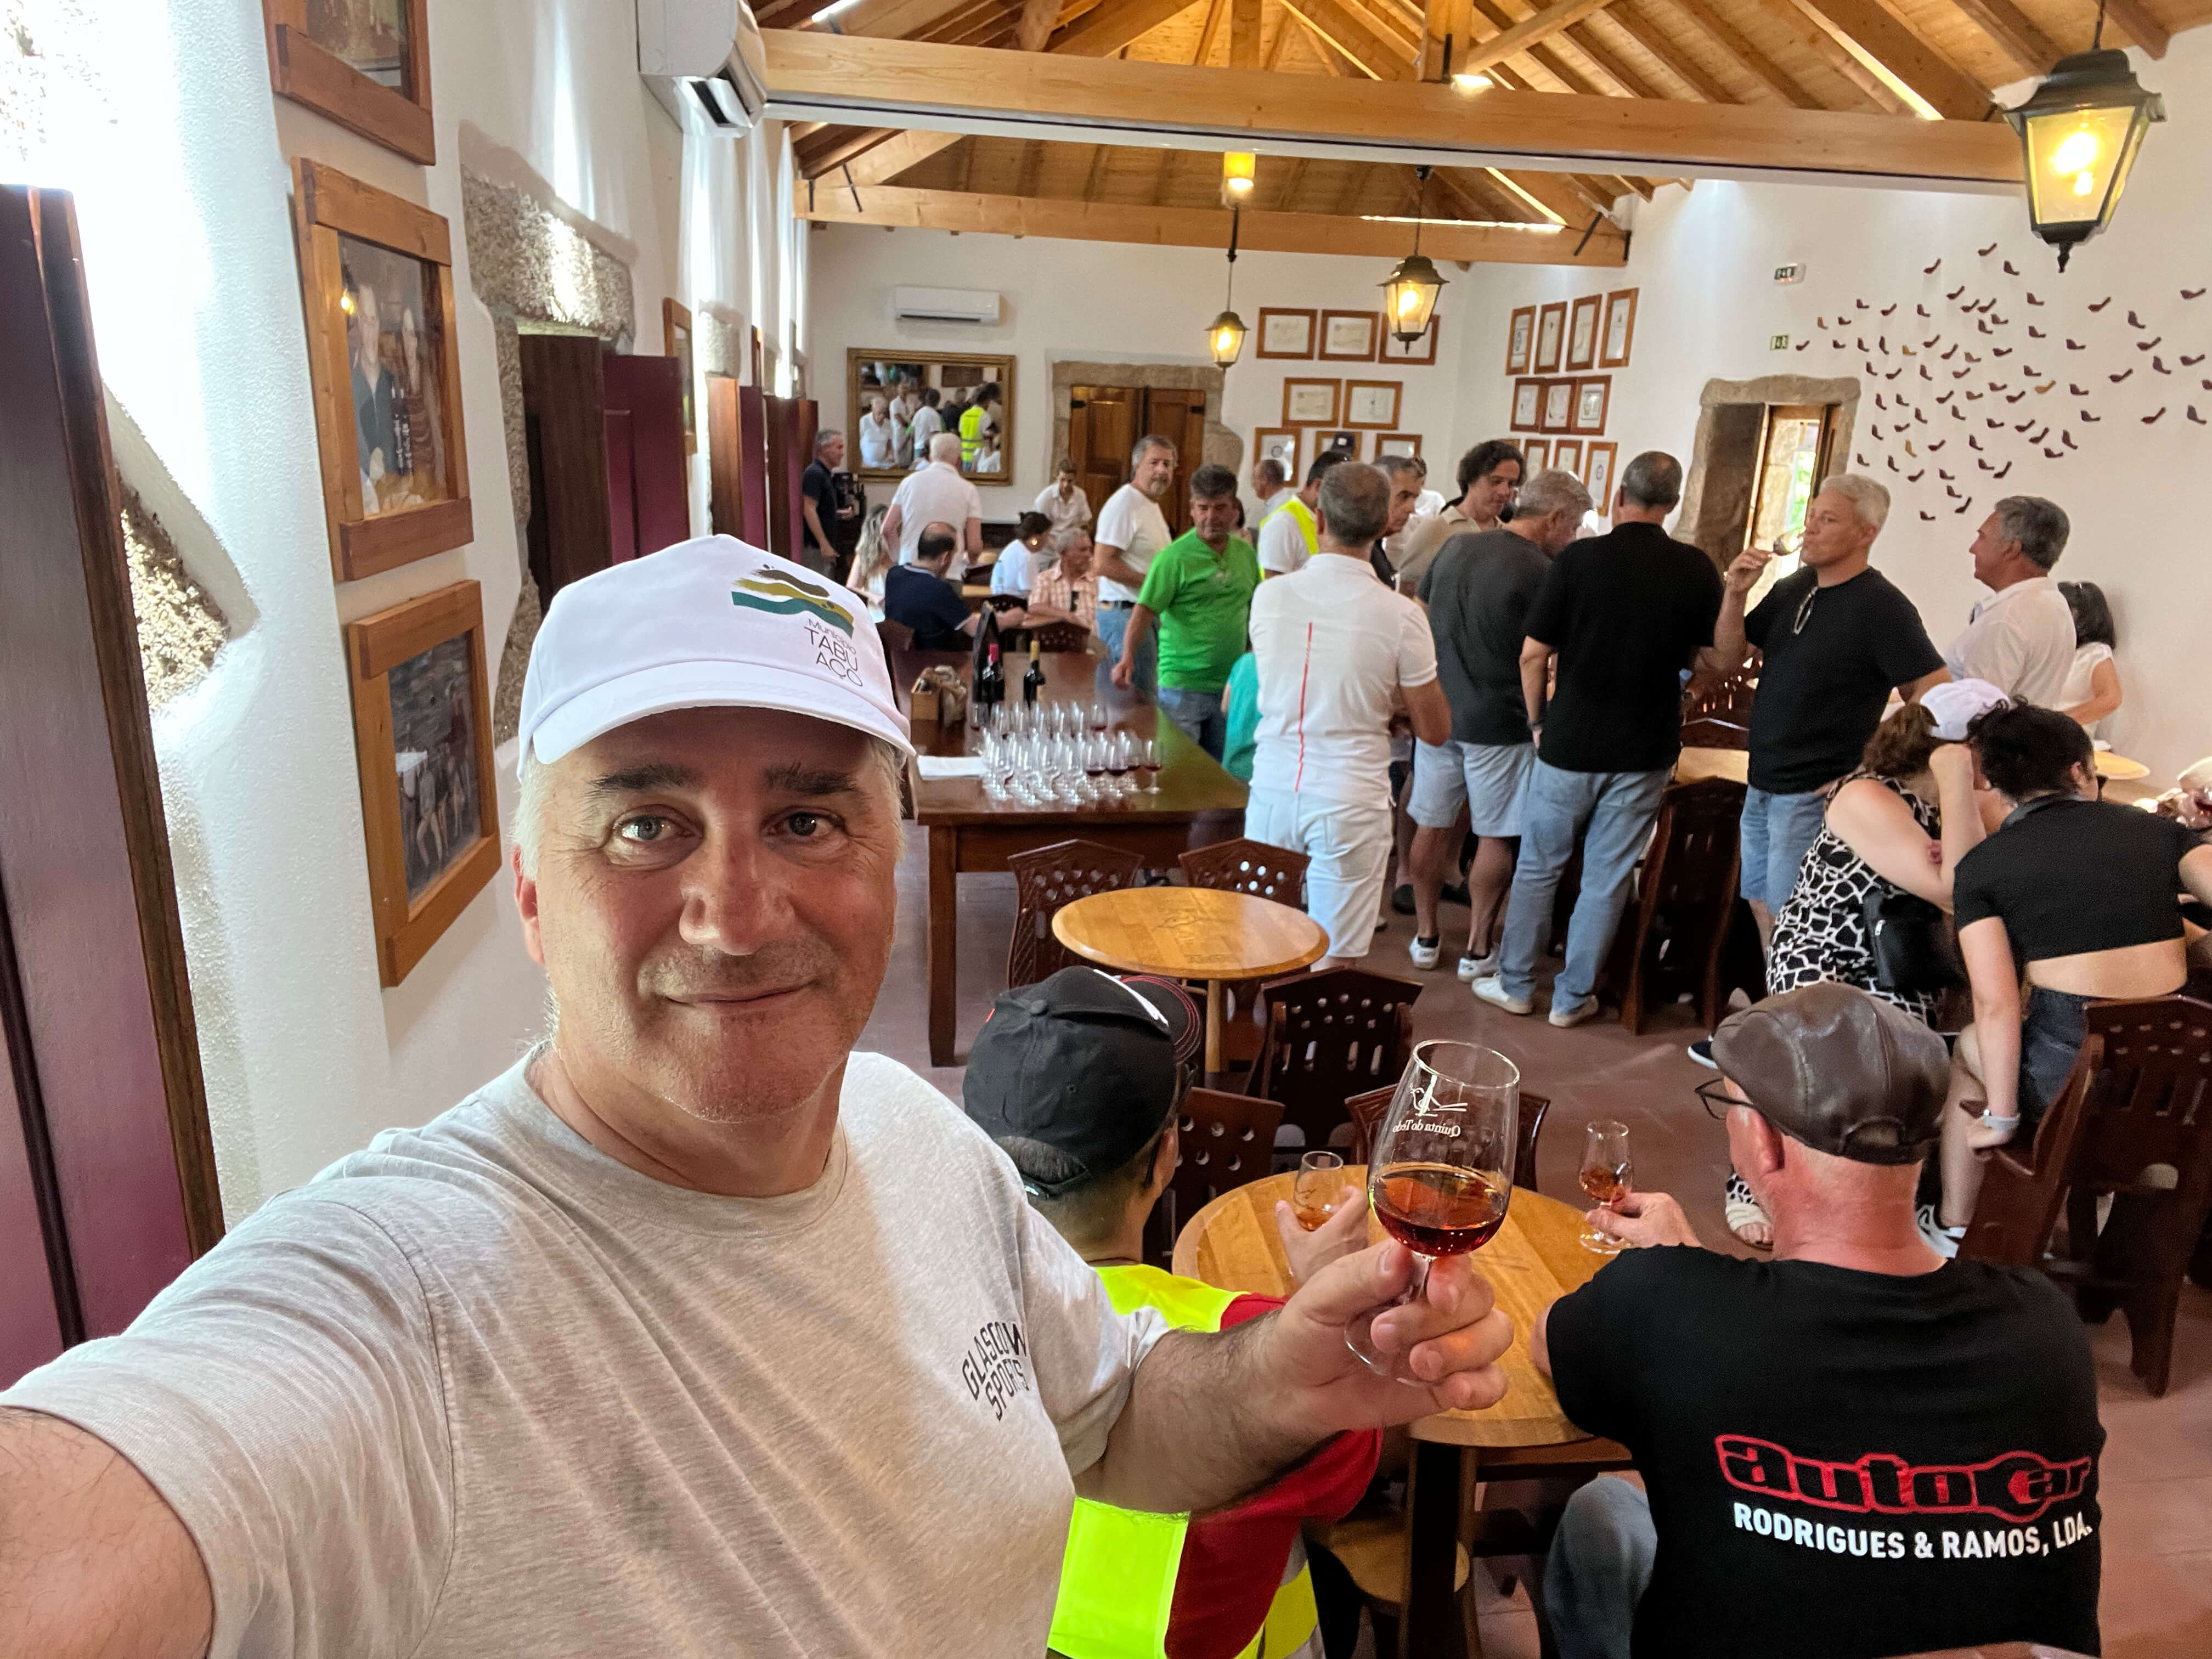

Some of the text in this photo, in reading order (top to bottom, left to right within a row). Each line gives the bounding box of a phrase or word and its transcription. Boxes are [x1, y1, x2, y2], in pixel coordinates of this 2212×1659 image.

[804, 627, 857, 671] TABU
[816, 652, 862, 687] AÇO
[1734, 1503, 2093, 1559] RODRIGUES & RAMOS, LDA.
